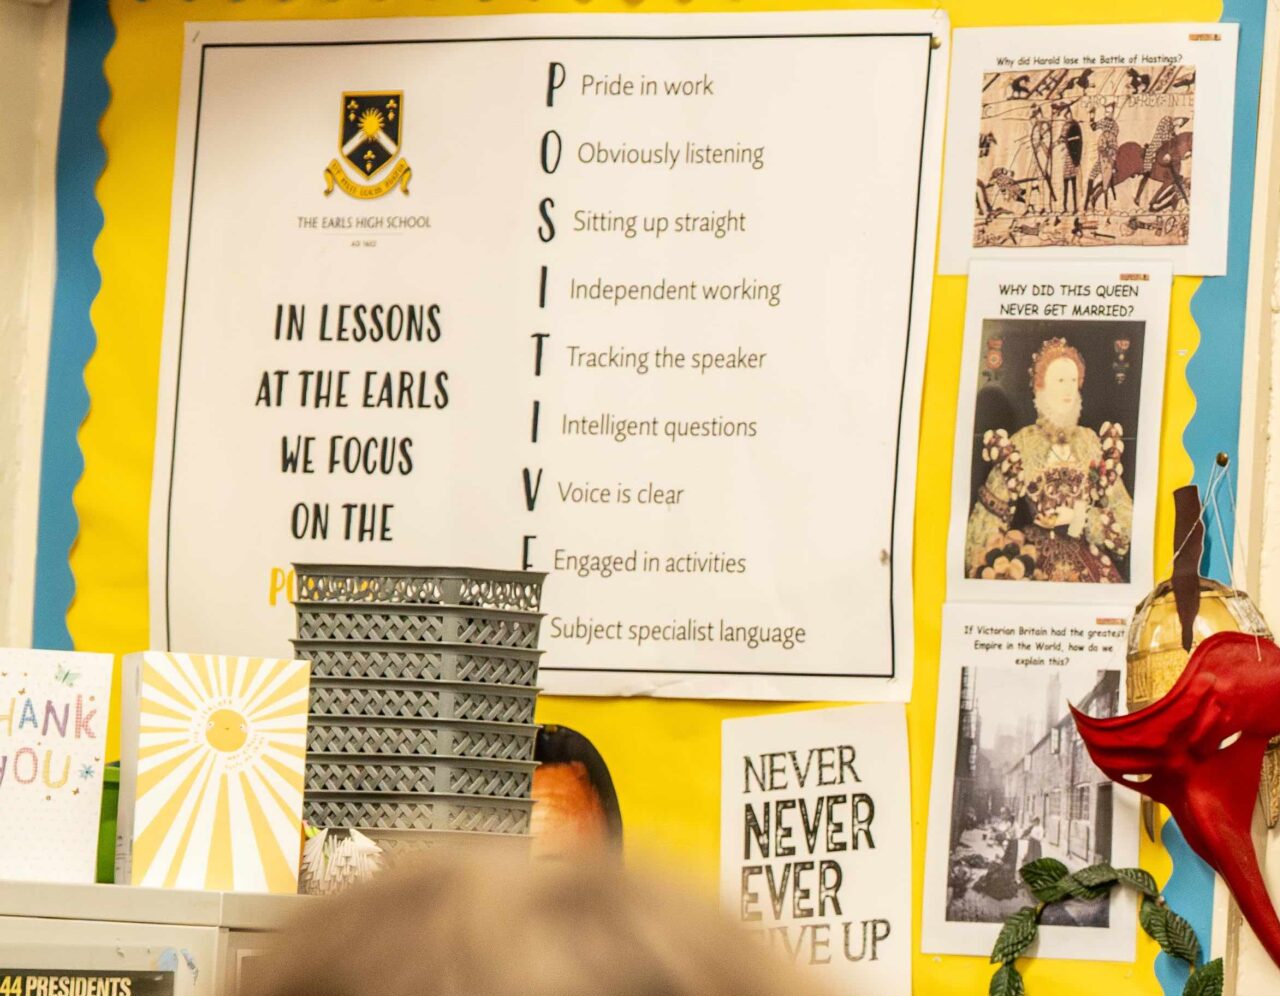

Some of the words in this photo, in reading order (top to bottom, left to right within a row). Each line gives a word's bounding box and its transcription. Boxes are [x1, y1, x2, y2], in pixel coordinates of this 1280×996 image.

[996, 57, 1014, 66] Why
[1018, 56, 1030, 65] did
[1033, 56, 1060, 65] Harold
[1063, 56, 1078, 65] lose
[1083, 56, 1095, 64] the
[1099, 55, 1124, 64] Battle
[1129, 55, 1138, 64] of
[1141, 54, 1182, 65] Hastings?
[581, 73, 634, 96] Pride
[640, 74, 657, 95] in
[664, 73, 714, 96] work
[577, 141, 680, 169] Obviously
[685, 142, 765, 170] listening
[298, 216, 318, 229] THE
[322, 216, 352, 229] EARLS
[355, 216, 383, 229] HIGH
[386, 215, 431, 228] SCHOOL
[573, 210, 637, 238] Sitting
[643, 216, 669, 238] up
[674, 211, 746, 238] straight
[570, 278, 697, 305] Independent
[702, 278, 781, 307] working
[999, 285, 1027, 296] WHY
[1032, 285, 1055, 296] DID
[1060, 285, 1091, 296] THIS
[1096, 285, 1139, 298] QUEEN
[274, 304, 305, 341] IN
[319, 304, 441, 342] LESSONS
[1000, 303, 1039, 316] NEVER
[1044, 304, 1067, 316] GET
[1072, 305, 1134, 317] MARRIED?
[567, 346, 649, 374] Tracking
[655, 347, 685, 368] the
[691, 347, 767, 374] speaker
[256, 370, 289, 407] AT
[298, 371, 349, 408] THE
[362, 371, 449, 409] EARLS
[562, 413, 659, 442] Intelligent
[664, 416, 757, 442] questions
[281, 435, 316, 474] WE
[328, 435, 414, 475] FOCUS
[558, 481, 611, 503] Voice
[617, 482, 631, 503] is
[638, 482, 684, 504] clear
[291, 502, 328, 540] ON
[342, 503, 394, 542] THE
[554, 549, 637, 578] Engaged
[643, 551, 660, 572] in
[665, 551, 747, 573] activities
[550, 616, 623, 644] Subject
[628, 619, 714, 645] specialist
[719, 619, 806, 650] language
[964, 626, 974, 635] If
[977, 626, 1015, 636] Victorian
[1019, 626, 1047, 636] Britain
[1051, 627, 1066, 636] had
[1070, 628, 1084, 637] the
[1088, 629, 1125, 639] greatest
[974, 641, 1002, 652] Empire
[1007, 642, 1014, 650] in
[1017, 641, 1031, 651] the
[1036, 642, 1064, 652] World,
[1068, 643, 1084, 652] how
[1088, 643, 1098, 652] do
[1015, 657, 1044, 667] explain
[1049, 657, 1069, 666] this?
[0, 694, 97, 739] HANK
[742, 744, 862, 793] NEVER
[744, 792, 876, 860] NEVER
[741, 860, 843, 921] EVER
[842, 918, 891, 962] UP
